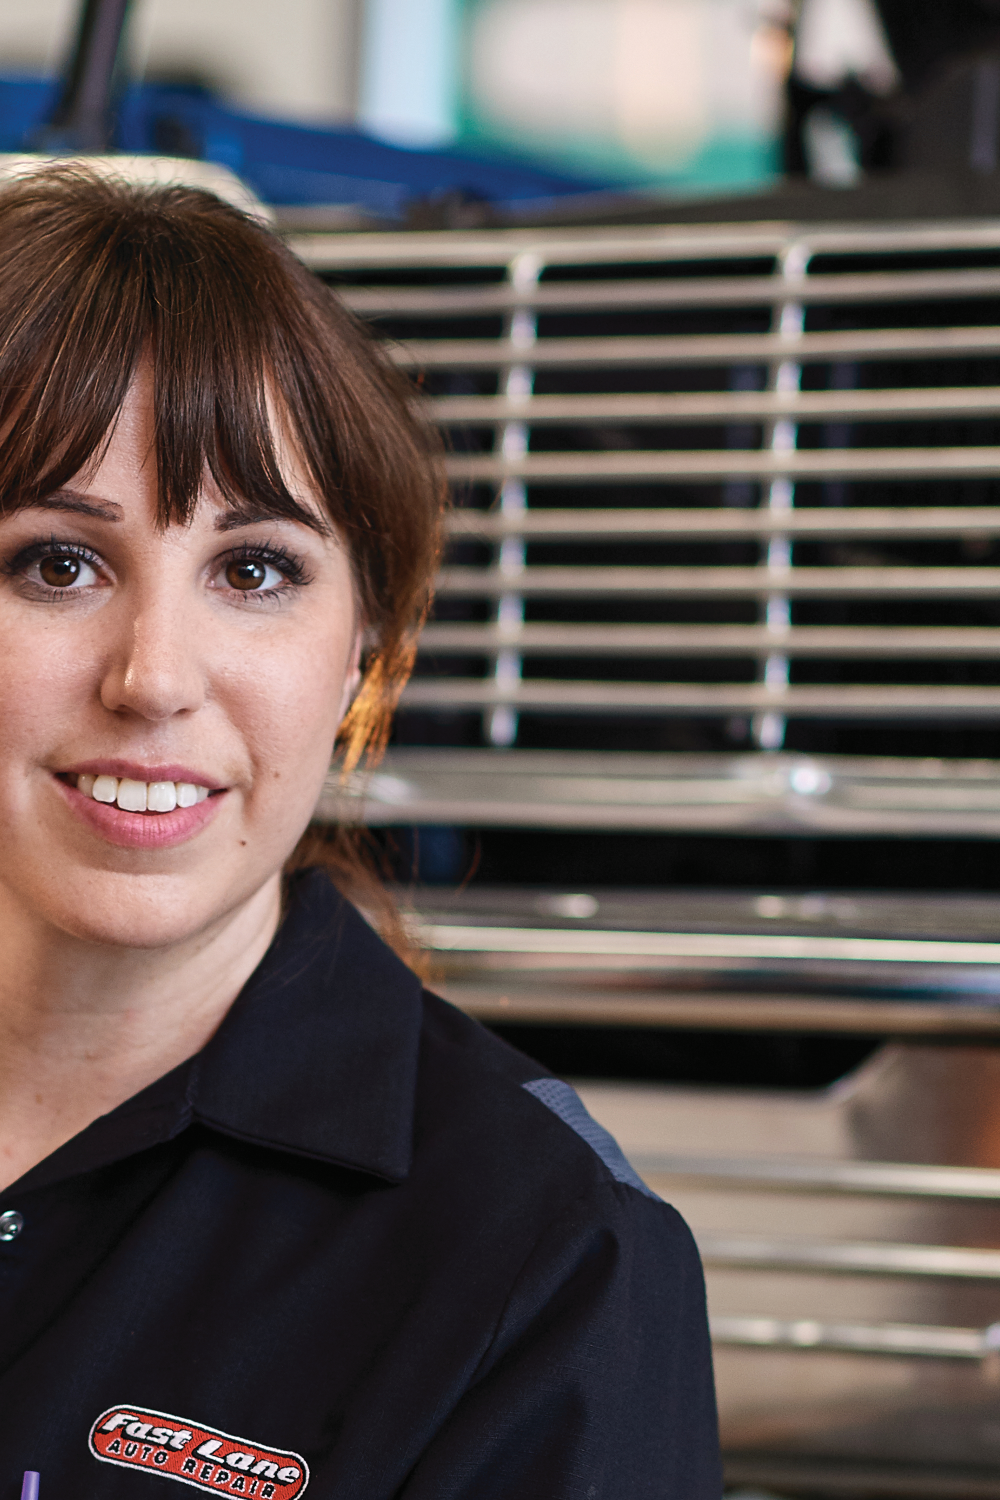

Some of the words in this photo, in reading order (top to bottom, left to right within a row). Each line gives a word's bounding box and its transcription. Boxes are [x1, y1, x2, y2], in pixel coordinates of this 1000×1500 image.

[99, 1412, 193, 1451] Fast
[195, 1438, 301, 1484] Lane
[106, 1439, 169, 1465] AUTO
[181, 1457, 277, 1500] REPAIR
